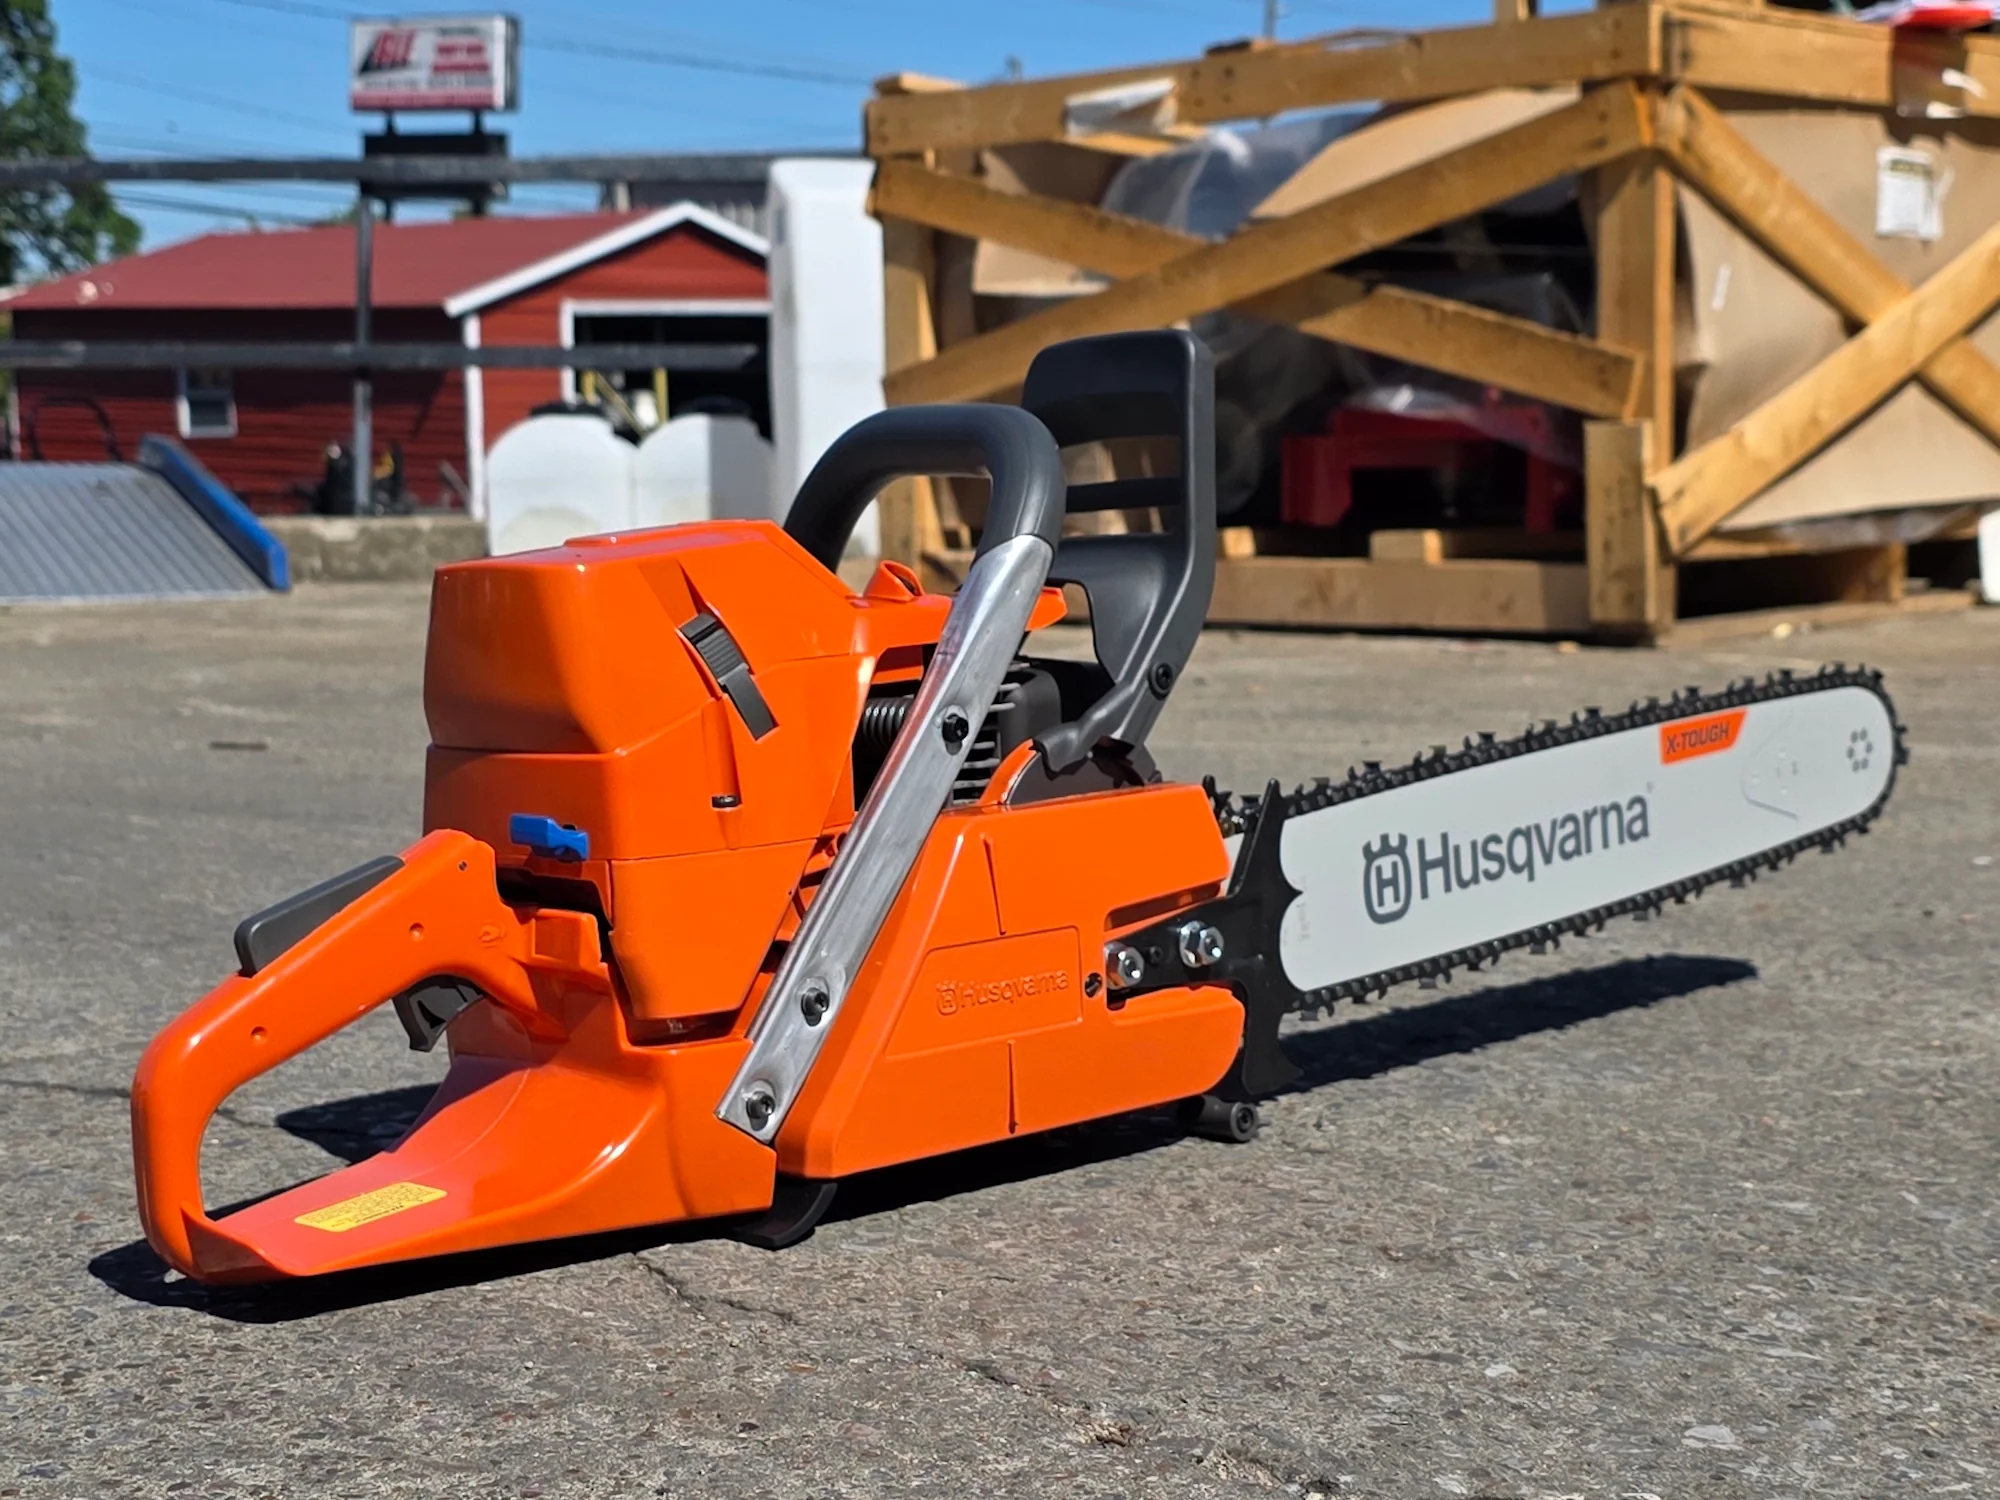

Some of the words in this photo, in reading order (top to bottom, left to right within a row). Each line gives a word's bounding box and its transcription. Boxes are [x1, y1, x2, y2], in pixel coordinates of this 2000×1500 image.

[1666, 720, 1731, 754] X-TOUGH
[1416, 794, 1650, 900] Husqvarna
[958, 969, 1069, 1009] Husqvarna
